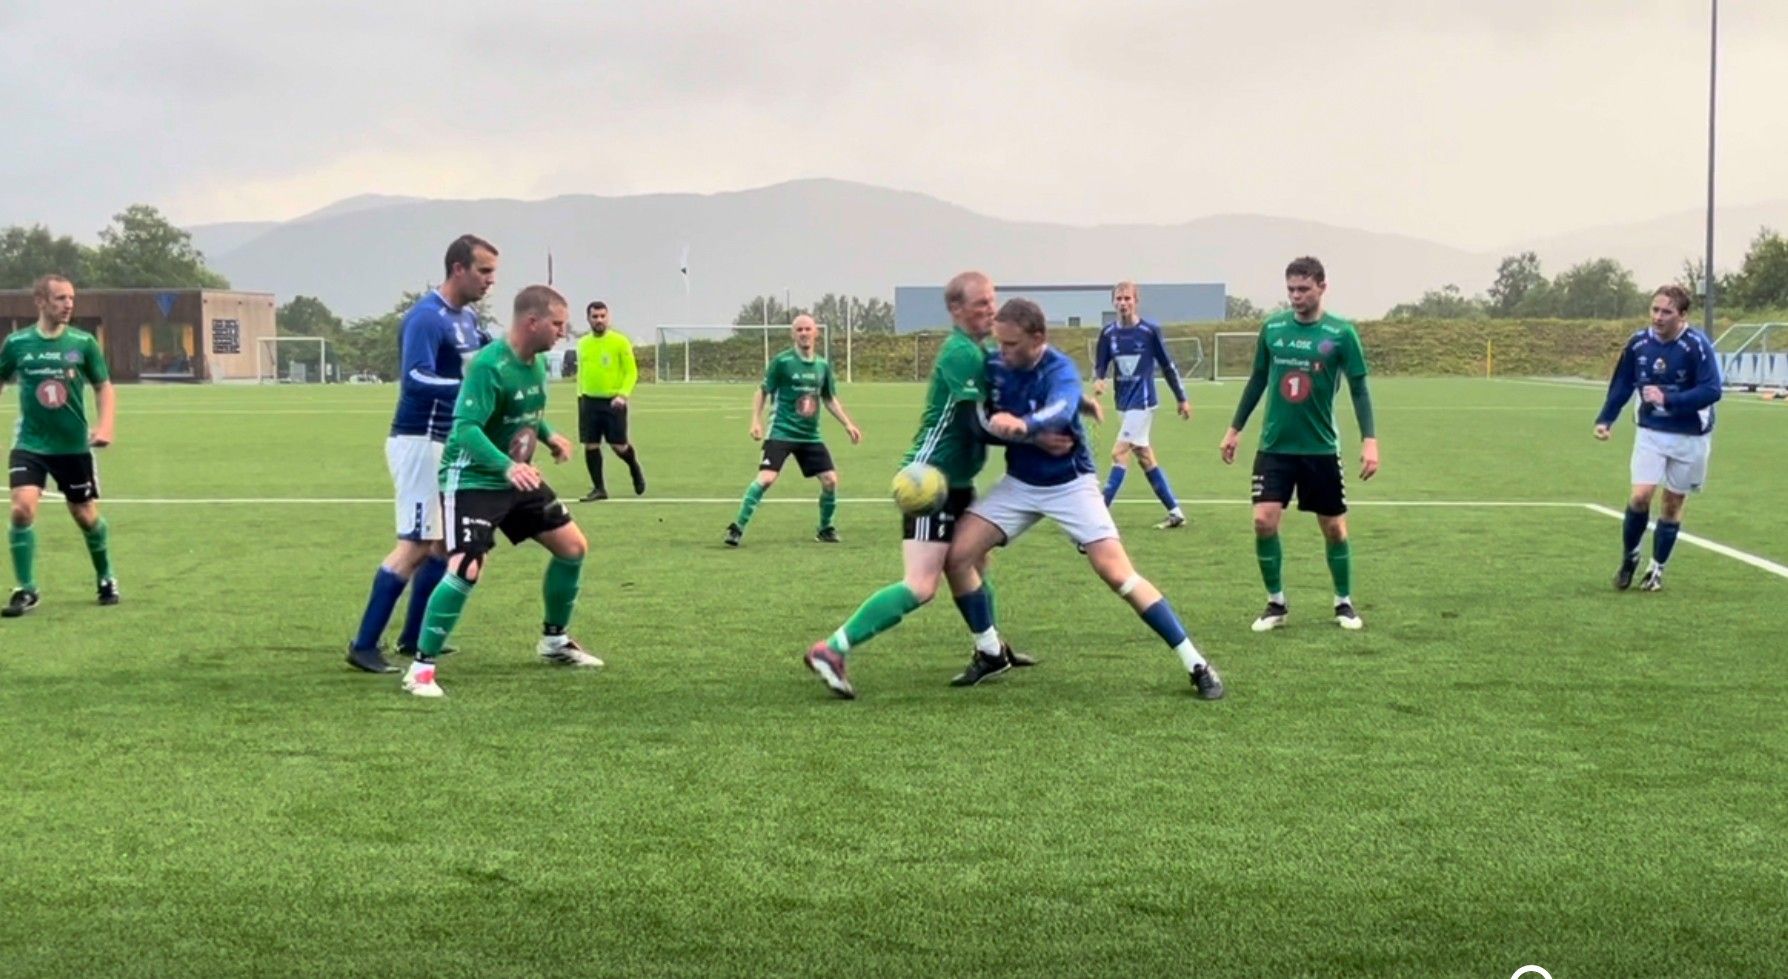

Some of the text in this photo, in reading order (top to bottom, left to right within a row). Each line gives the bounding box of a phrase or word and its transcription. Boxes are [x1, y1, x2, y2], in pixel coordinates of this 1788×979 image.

[43, 383, 58, 404] 1
[1287, 376, 1300, 397] 1
[463, 528, 472, 542] 2
